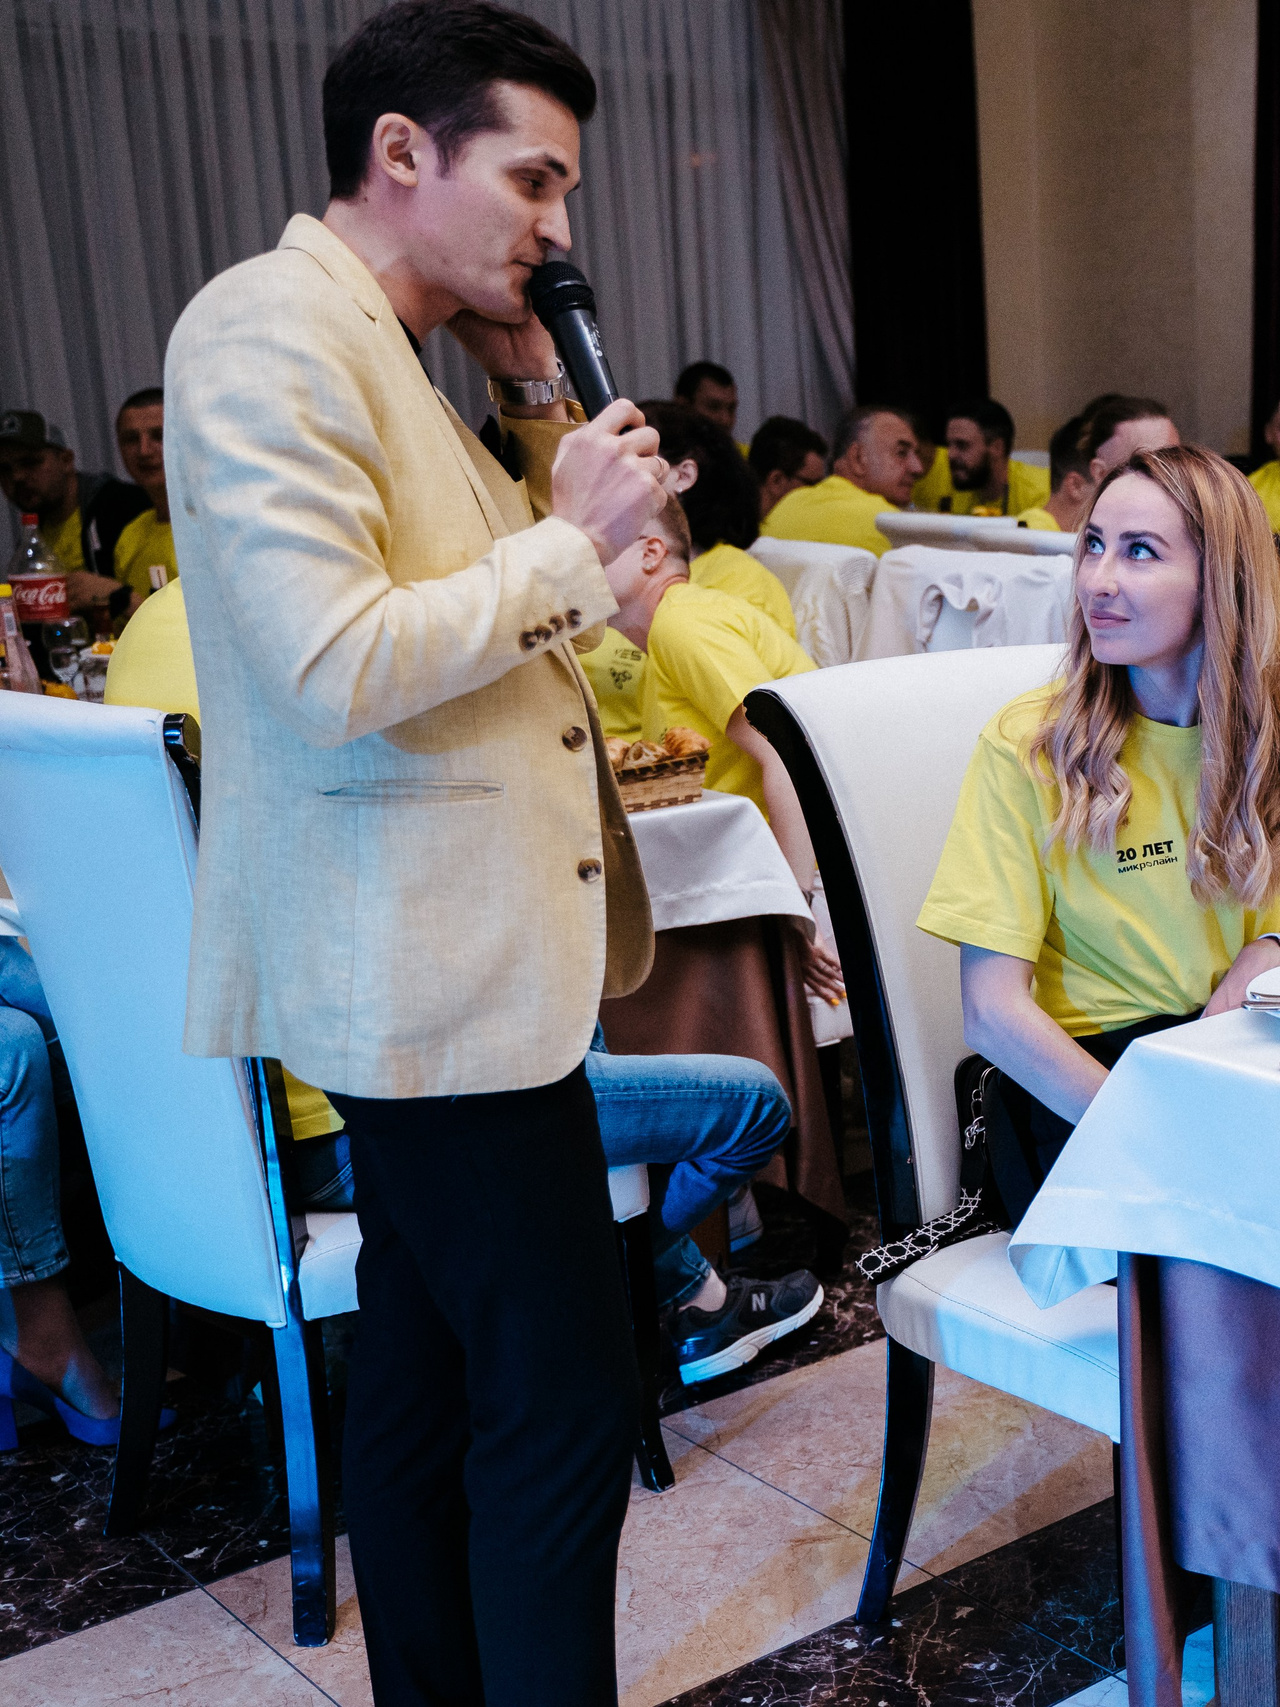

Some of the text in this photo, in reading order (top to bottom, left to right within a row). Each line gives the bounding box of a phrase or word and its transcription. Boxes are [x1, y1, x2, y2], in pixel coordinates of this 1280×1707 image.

[1117, 840, 1174, 863] 20 ЛЕТ
[1117, 855, 1178, 874] микролайн
[751, 1293, 767, 1312] N
